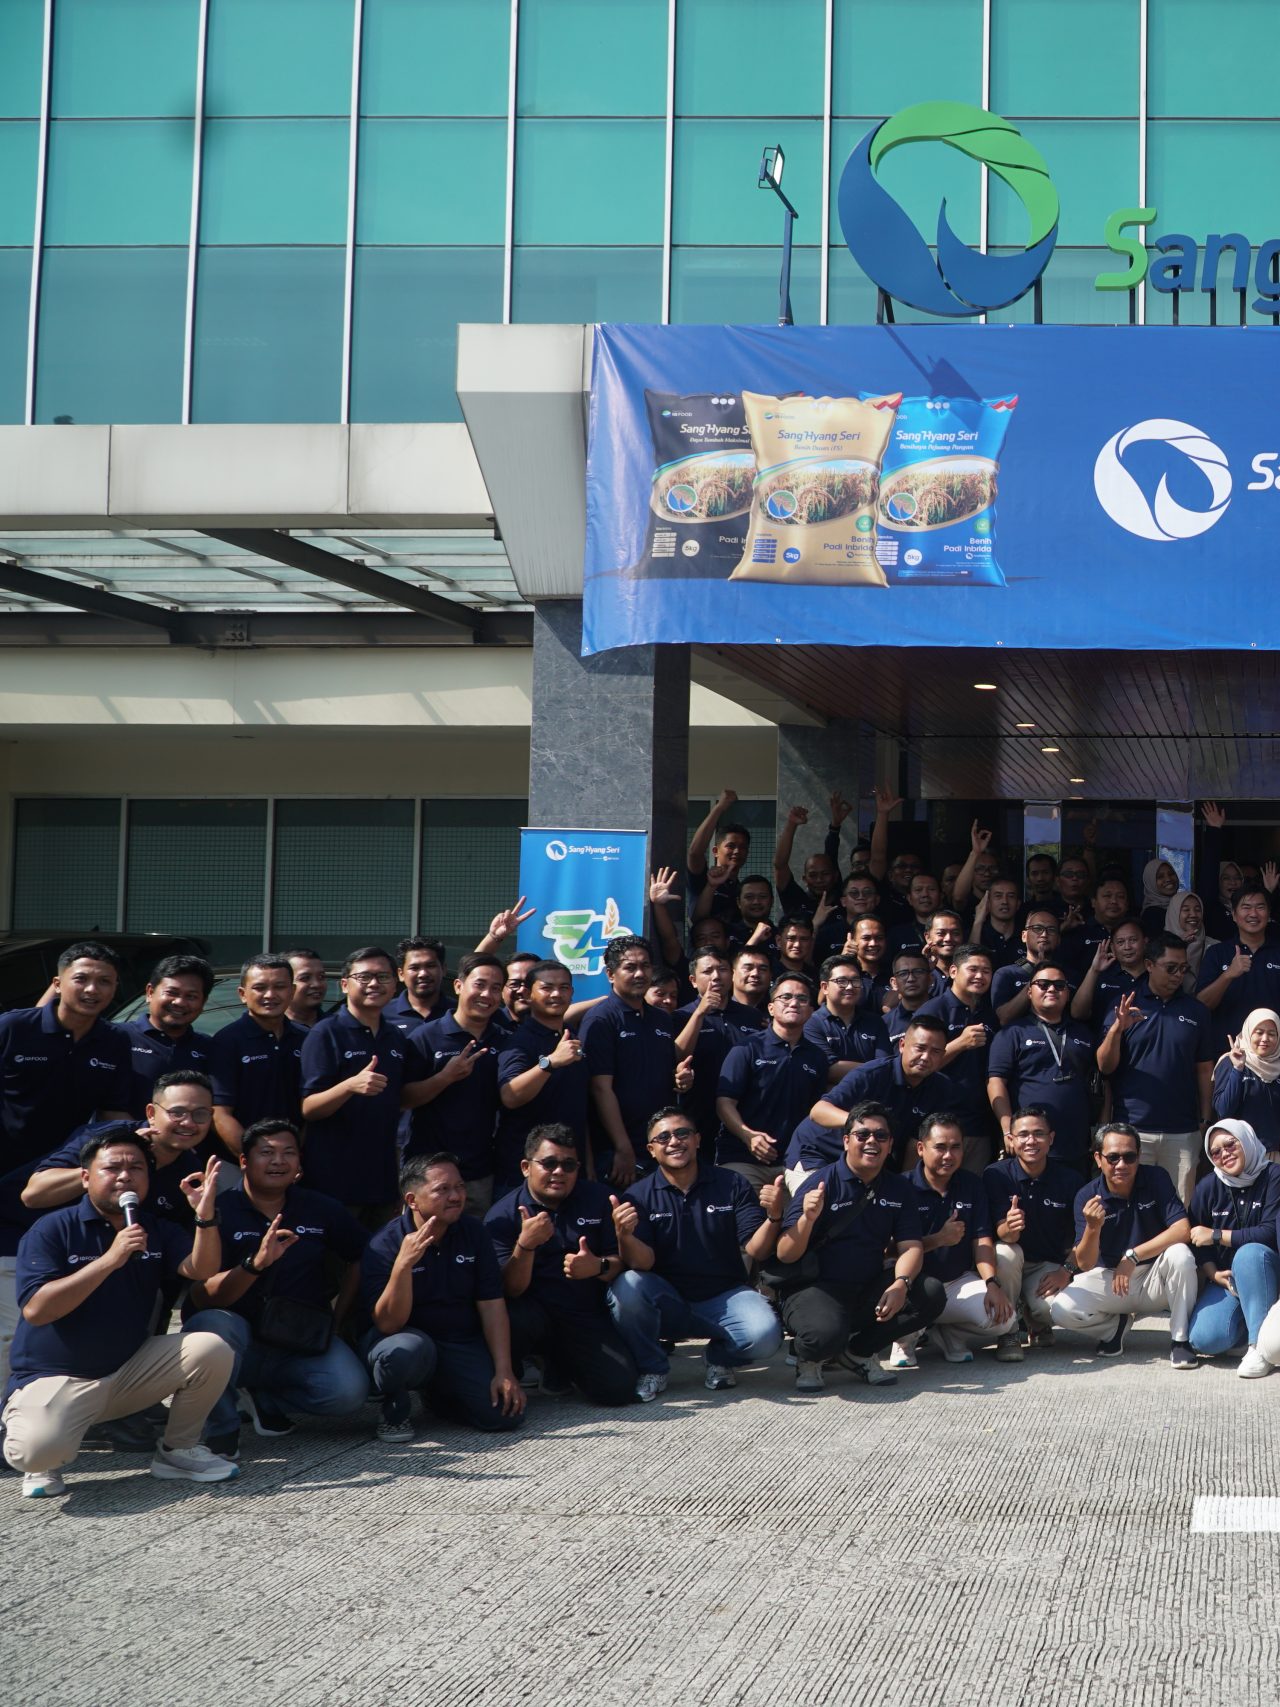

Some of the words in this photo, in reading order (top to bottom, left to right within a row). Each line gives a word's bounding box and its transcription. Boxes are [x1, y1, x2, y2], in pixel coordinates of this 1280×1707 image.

[839, 431, 861, 441] Seri
[957, 430, 979, 441] Seri
[719, 535, 739, 544] Padi
[969, 537, 992, 545] Benih
[845, 543, 874, 551] Inbrida
[785, 552, 799, 560] 5kg
